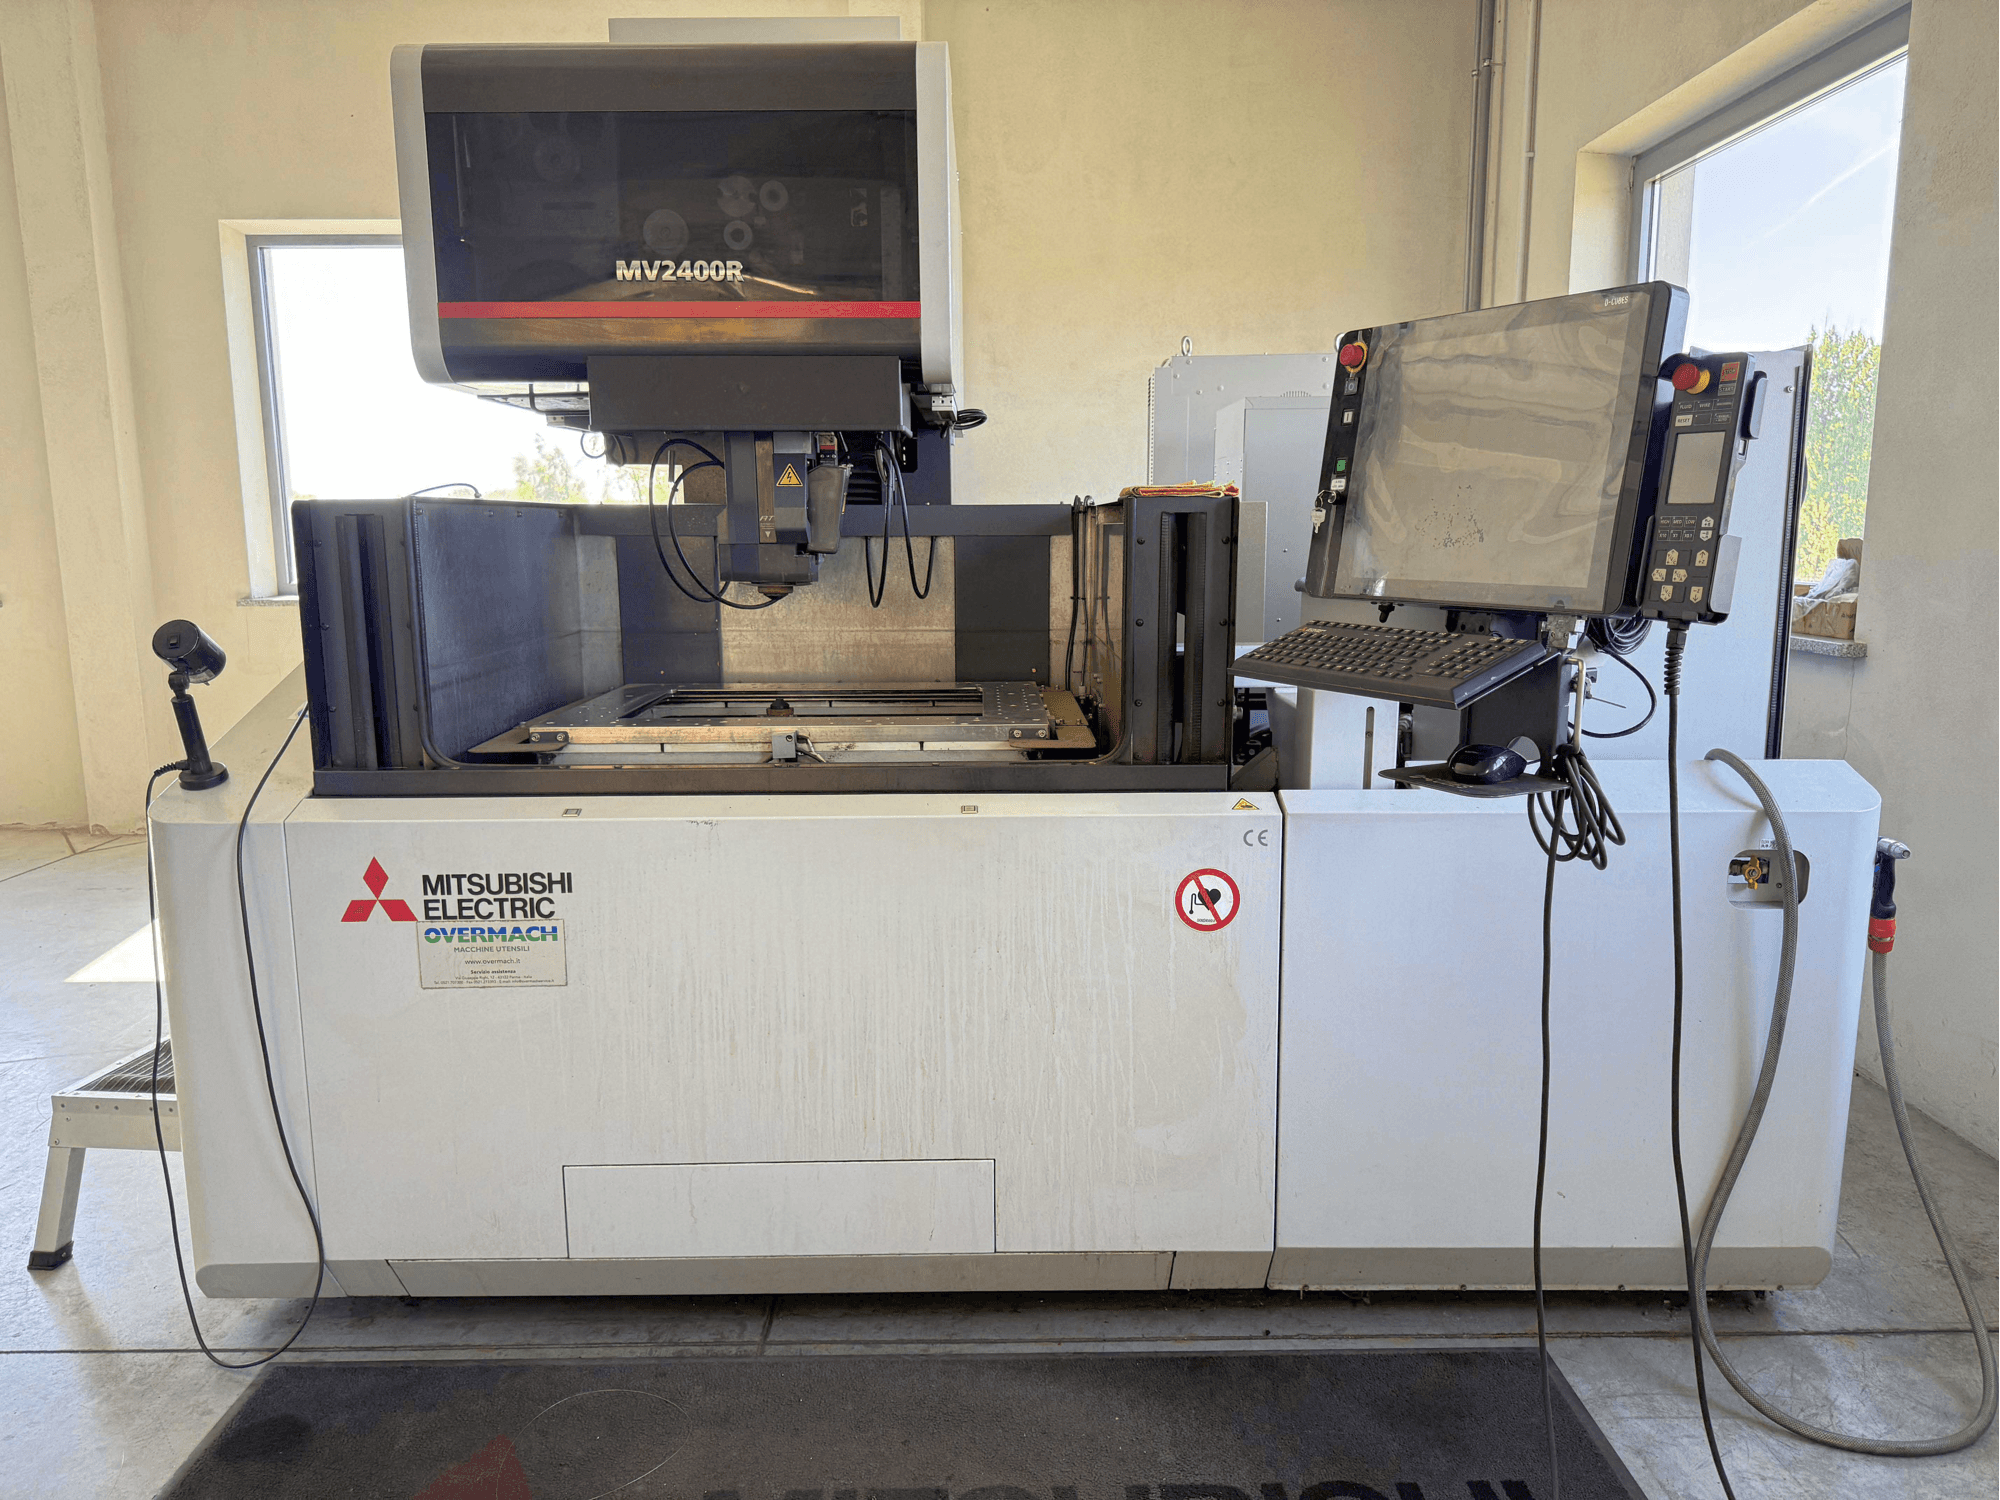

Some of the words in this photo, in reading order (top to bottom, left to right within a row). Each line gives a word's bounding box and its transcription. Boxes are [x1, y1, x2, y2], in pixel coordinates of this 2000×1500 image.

[616, 260, 744, 282] MV2400R
[1243, 829, 1268, 846] CE
[422, 872, 573, 895] MITSUBISHI
[423, 897, 556, 920] ELECTRIC
[424, 925, 558, 944] OVERMACH
